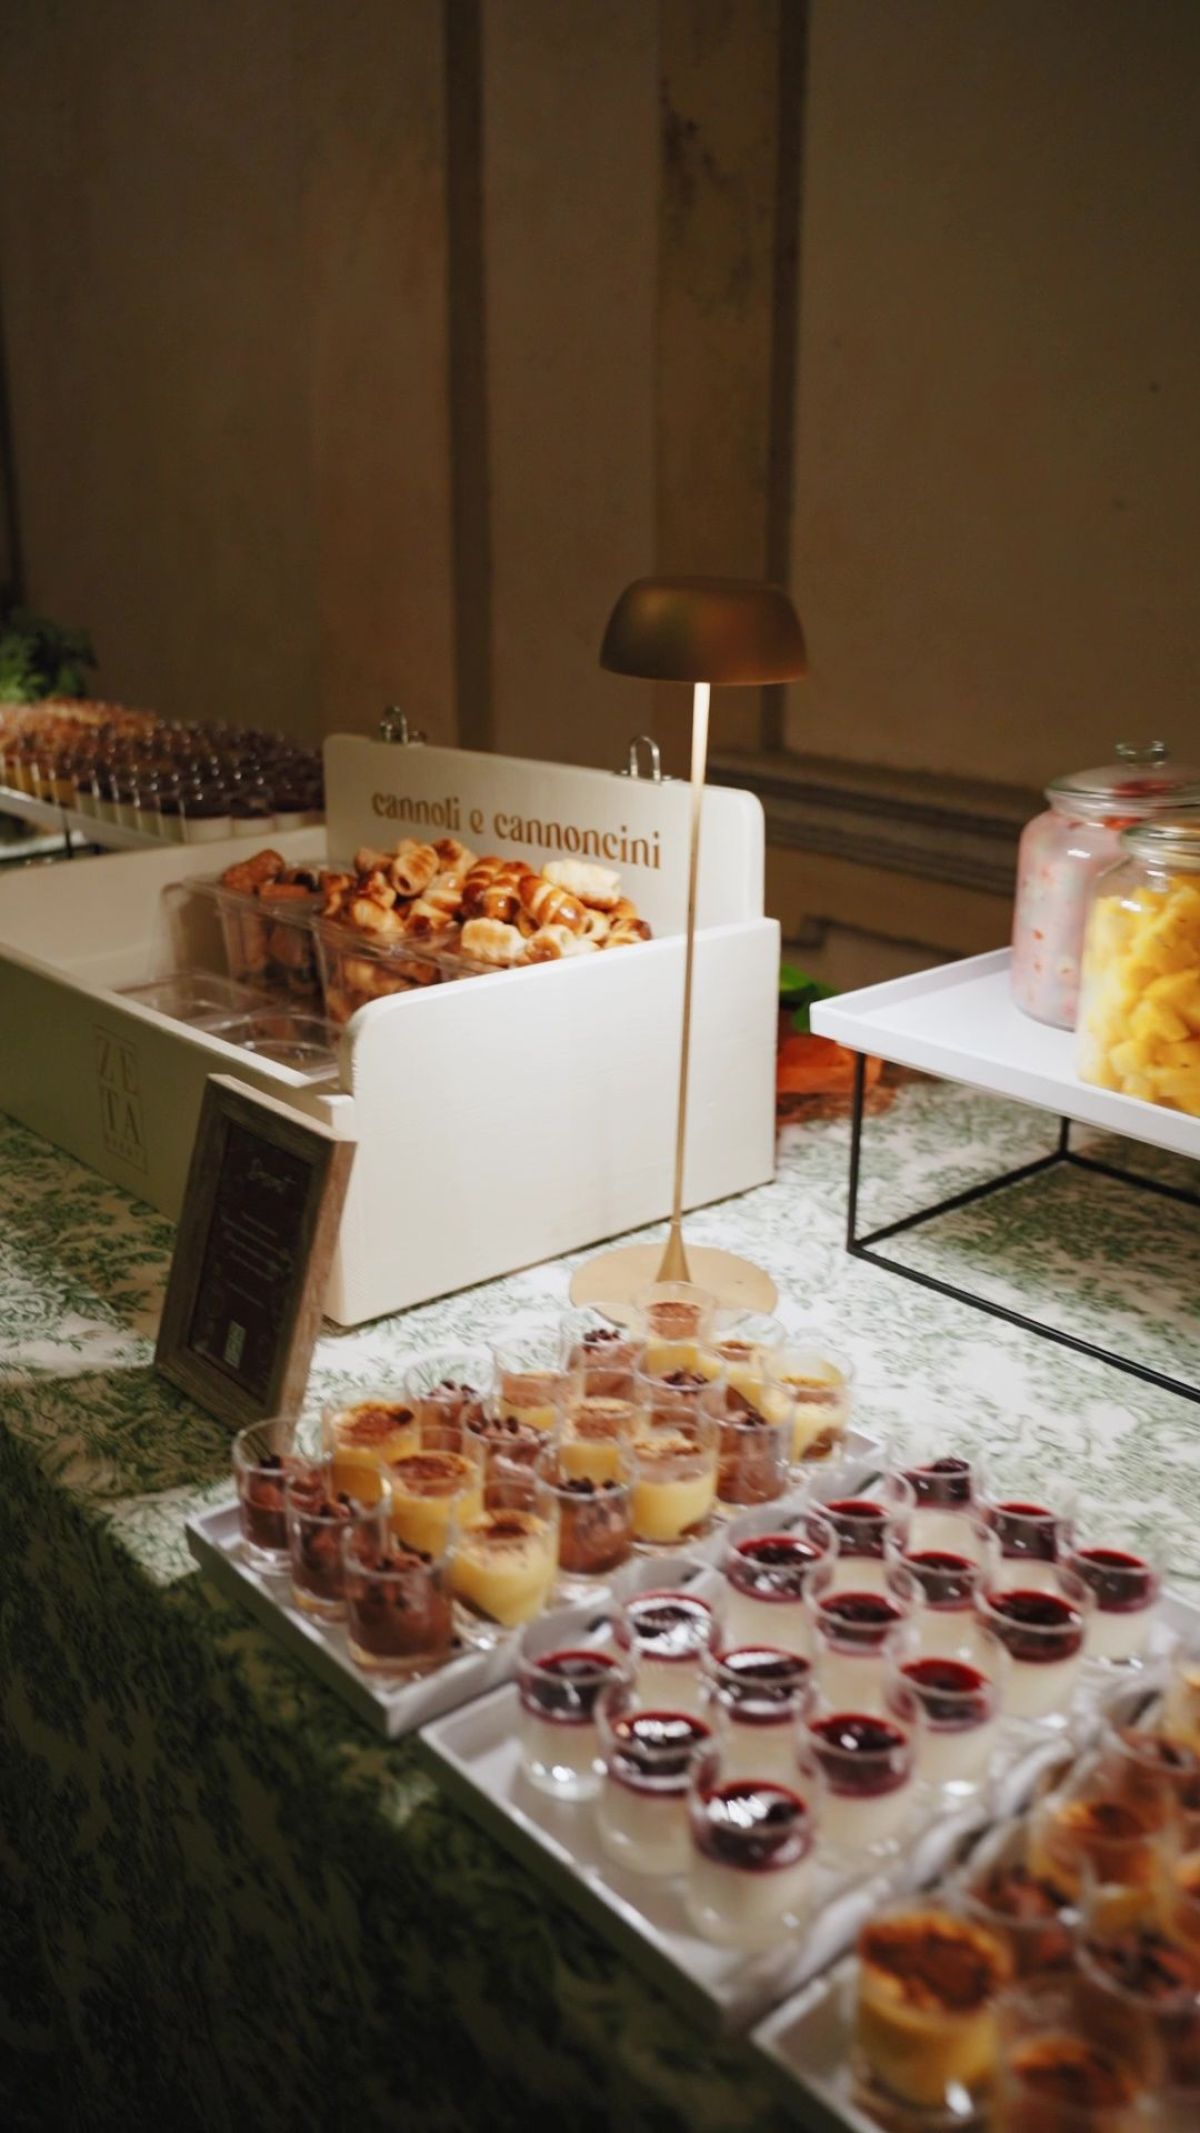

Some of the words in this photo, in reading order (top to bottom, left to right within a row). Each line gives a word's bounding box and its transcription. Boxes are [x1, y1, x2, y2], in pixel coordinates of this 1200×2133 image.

[371, 791, 460, 832] cannoli
[469, 808, 484, 834] e
[494, 813, 660, 869] cannoncini
[96, 1034, 138, 1097] ZE
[100, 1085, 141, 1146] TA
